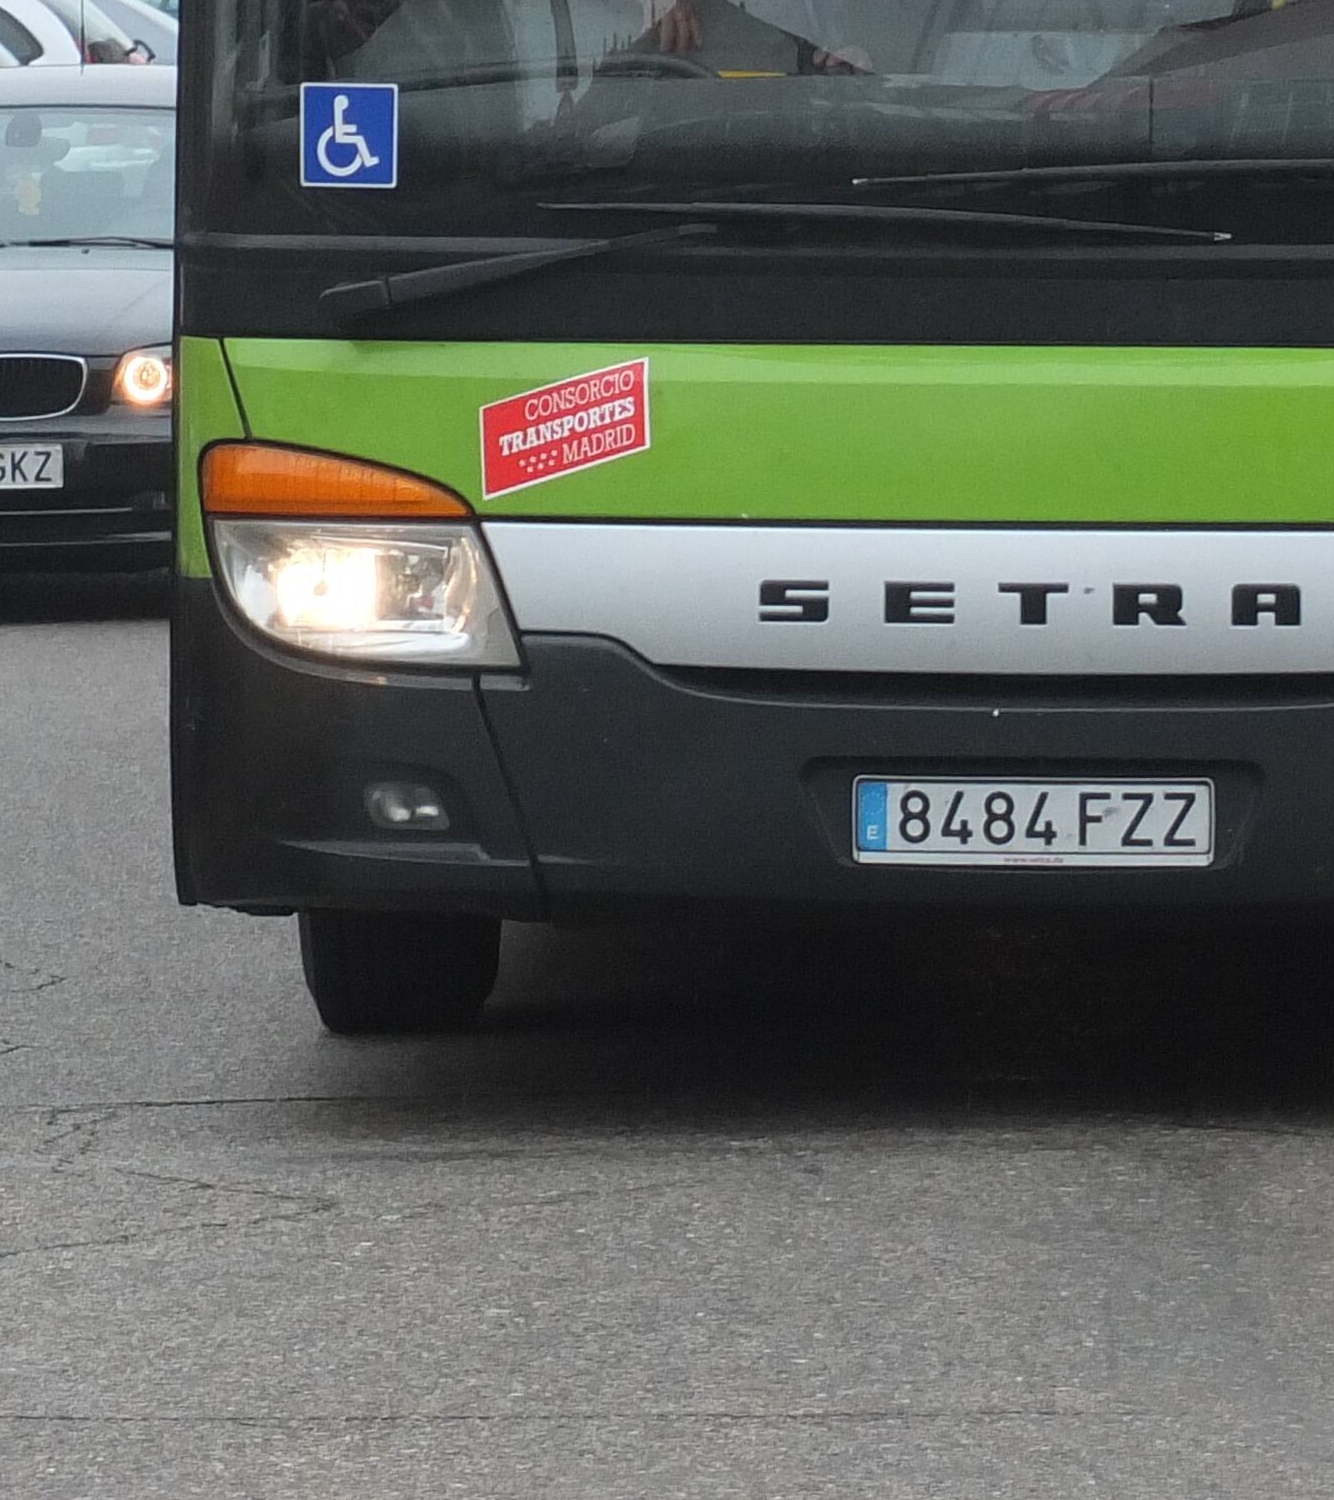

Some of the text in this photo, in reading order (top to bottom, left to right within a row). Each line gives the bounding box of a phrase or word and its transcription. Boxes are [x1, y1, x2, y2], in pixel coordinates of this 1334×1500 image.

[524, 370, 635, 421] CONSORCIO
[498, 396, 635, 457] TRANSPORTES
[562, 423, 636, 465] MADRID
[759, 580, 1302, 626] SETRA
[898, 789, 1058, 846] 8484
[1078, 791, 1197, 847] FZZ
